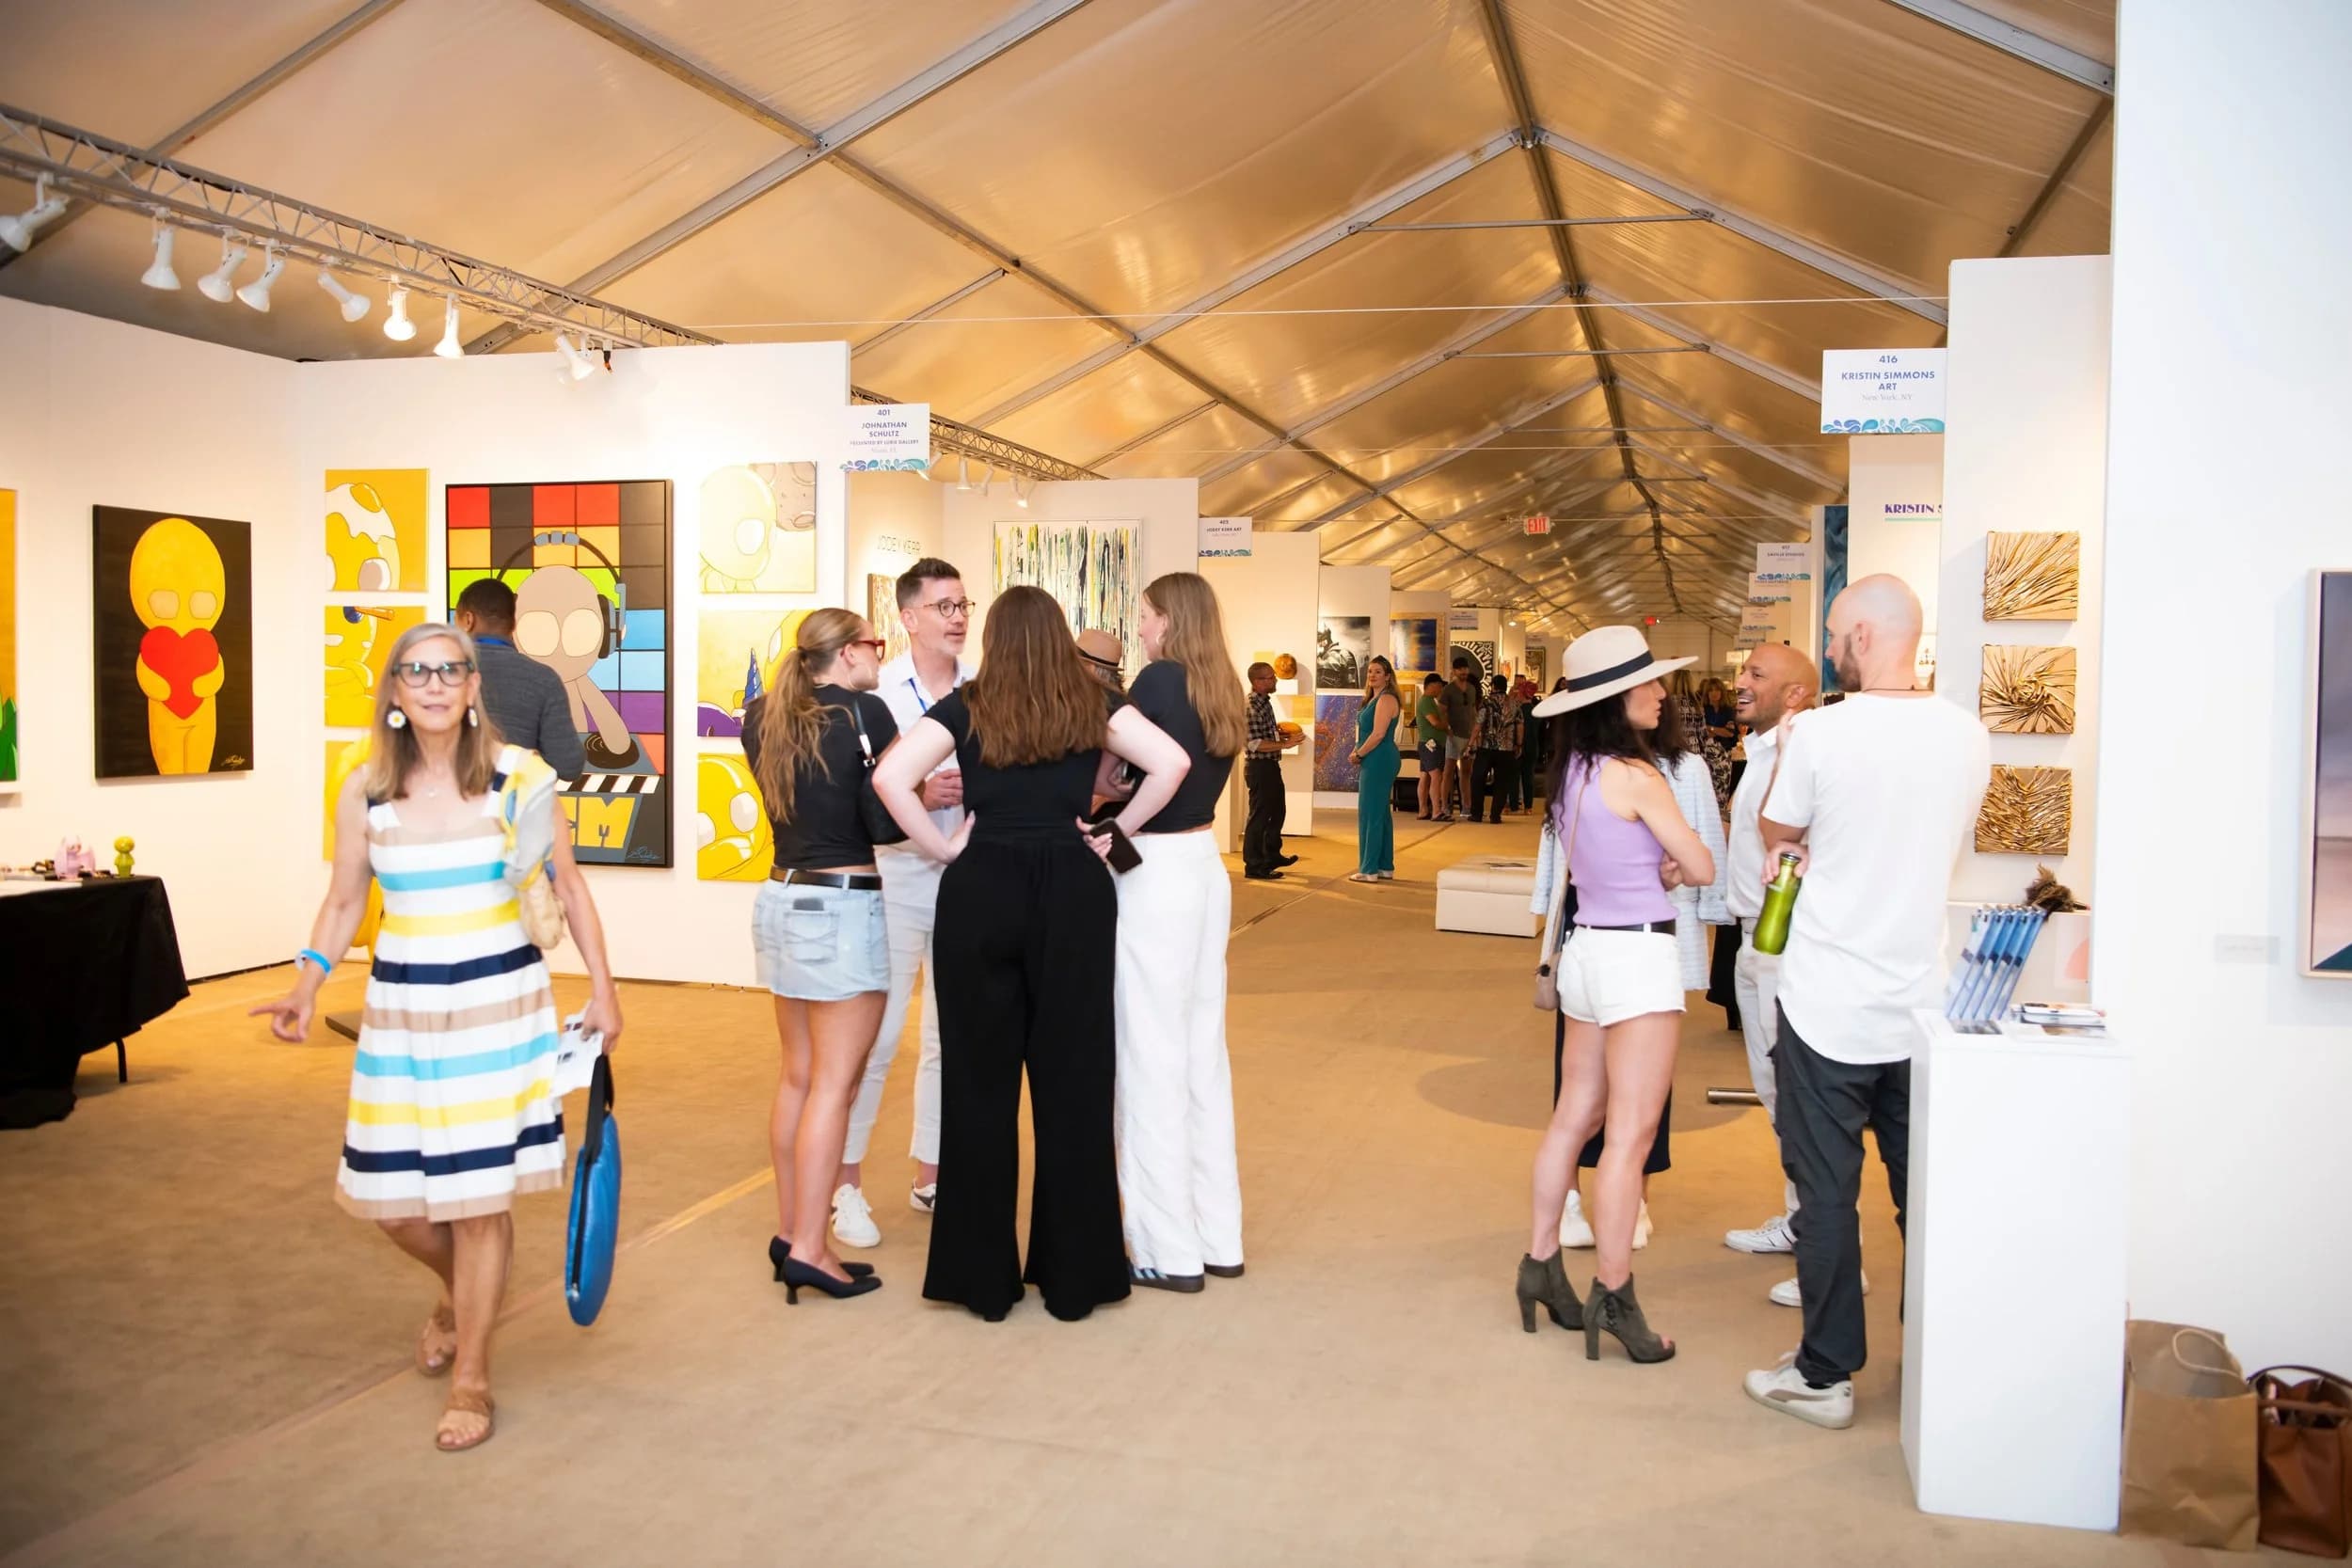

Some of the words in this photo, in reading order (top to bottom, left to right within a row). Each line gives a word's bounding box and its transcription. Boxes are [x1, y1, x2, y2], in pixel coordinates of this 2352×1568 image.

[1841, 372, 1881, 380] KRISTIN
[1883, 371, 1935, 380] SIMMONS
[1884, 503, 1934, 514] KRISTIN
